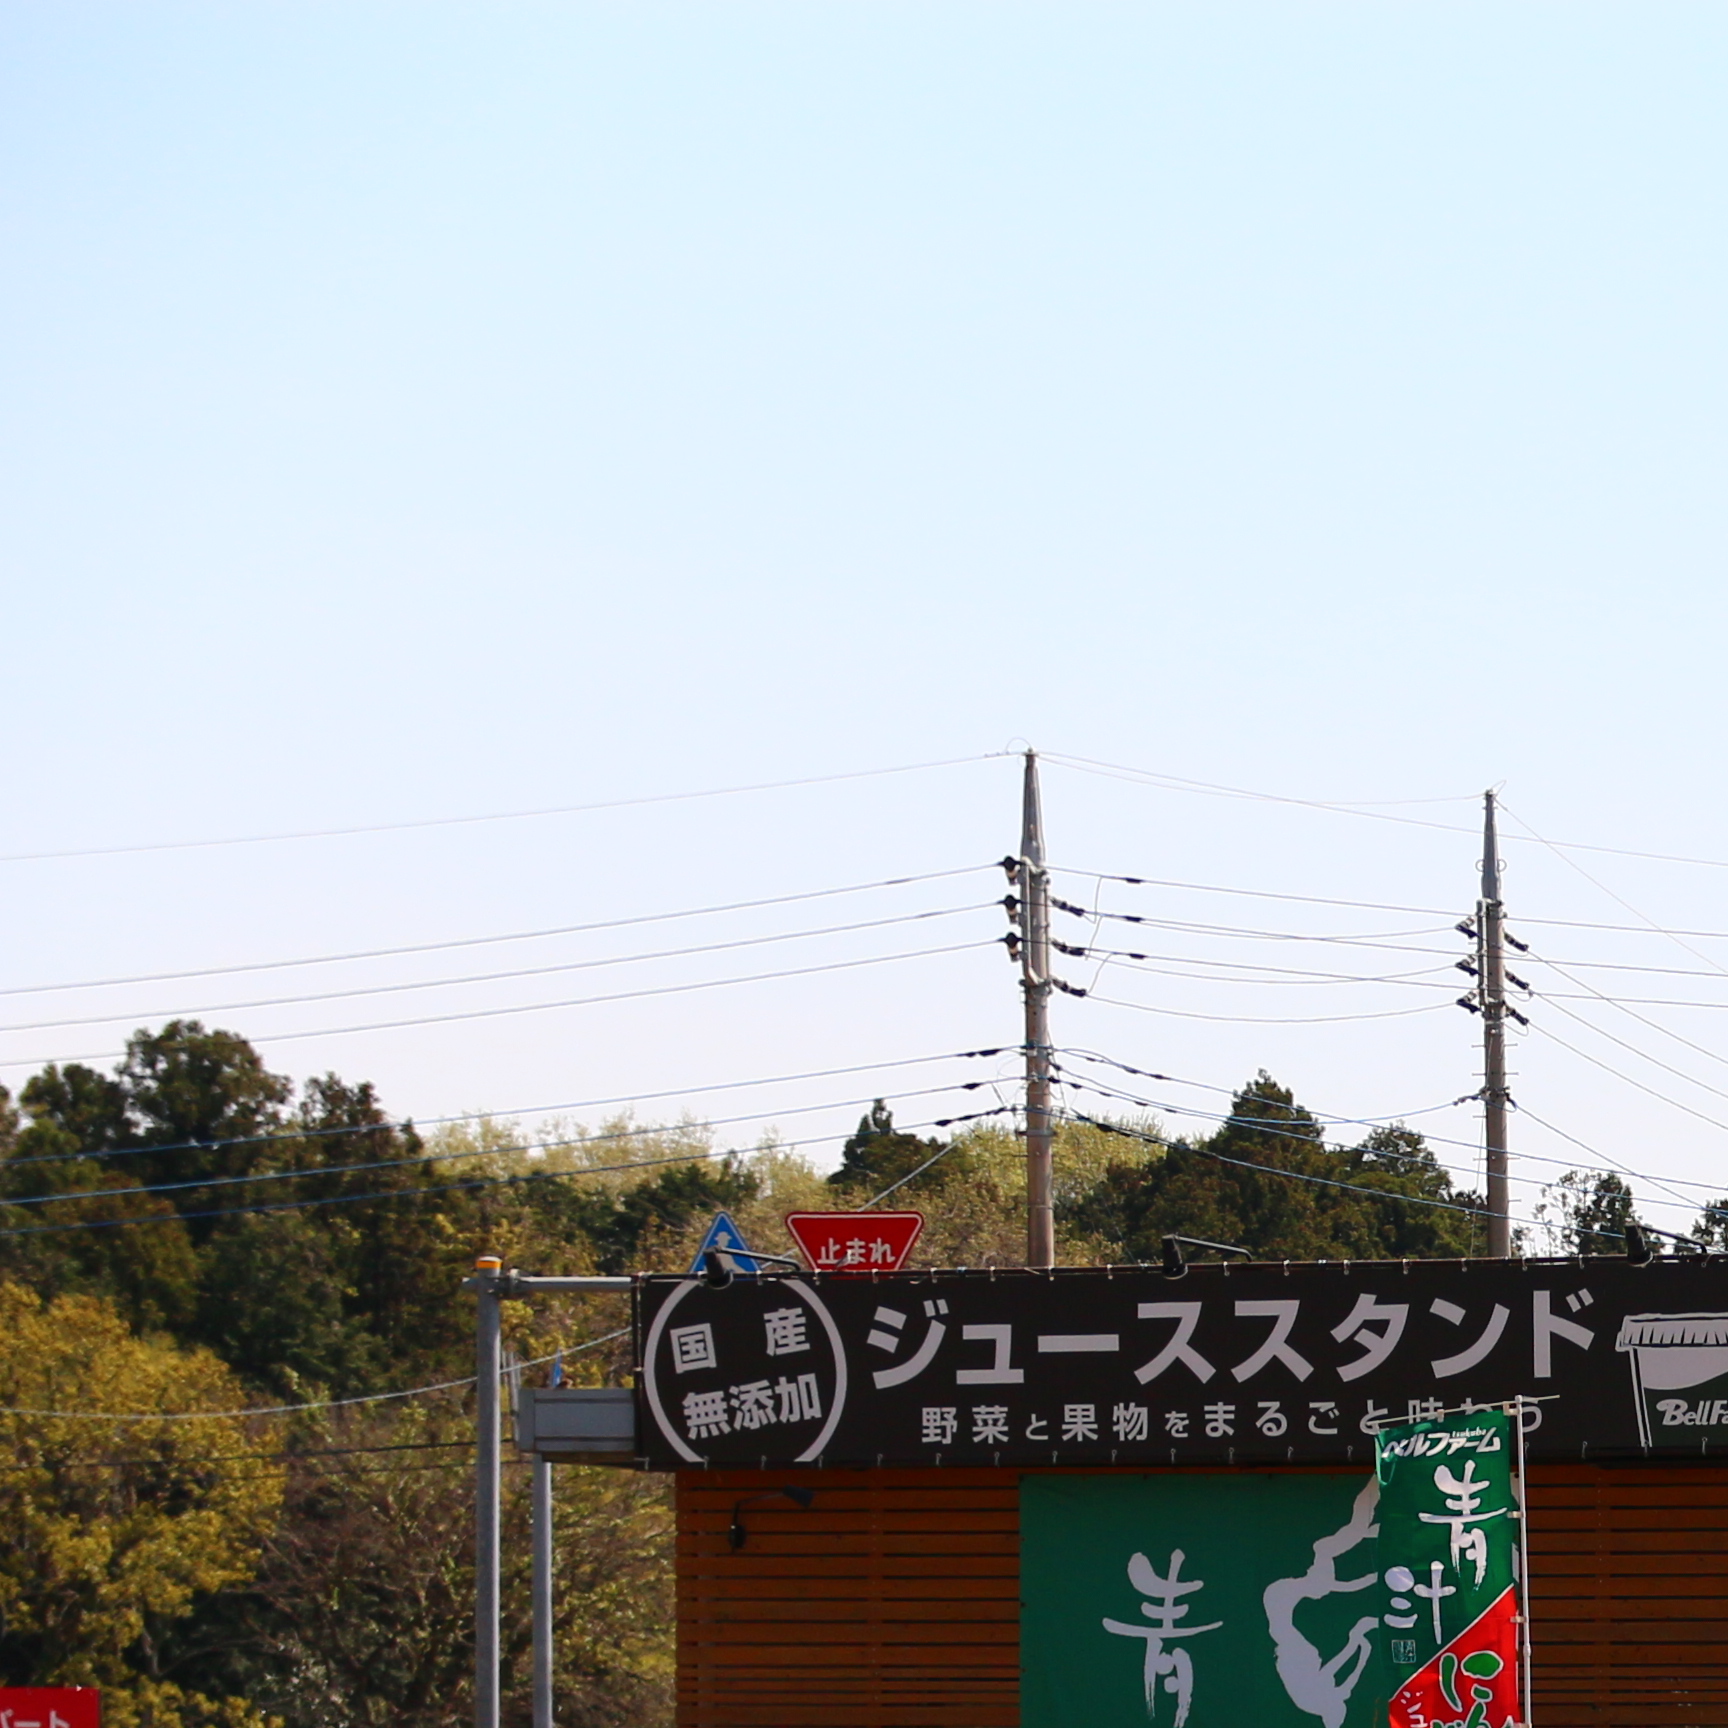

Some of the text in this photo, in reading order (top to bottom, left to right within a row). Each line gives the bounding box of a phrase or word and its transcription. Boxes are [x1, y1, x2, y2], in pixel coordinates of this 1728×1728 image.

[817, 1237, 897, 1265] 止まれ
[866, 1287, 1595, 1391] ジューススタンド
[682, 1375, 823, 1441] 無添加
[1384, 1459, 1508, 1645] 青汁
